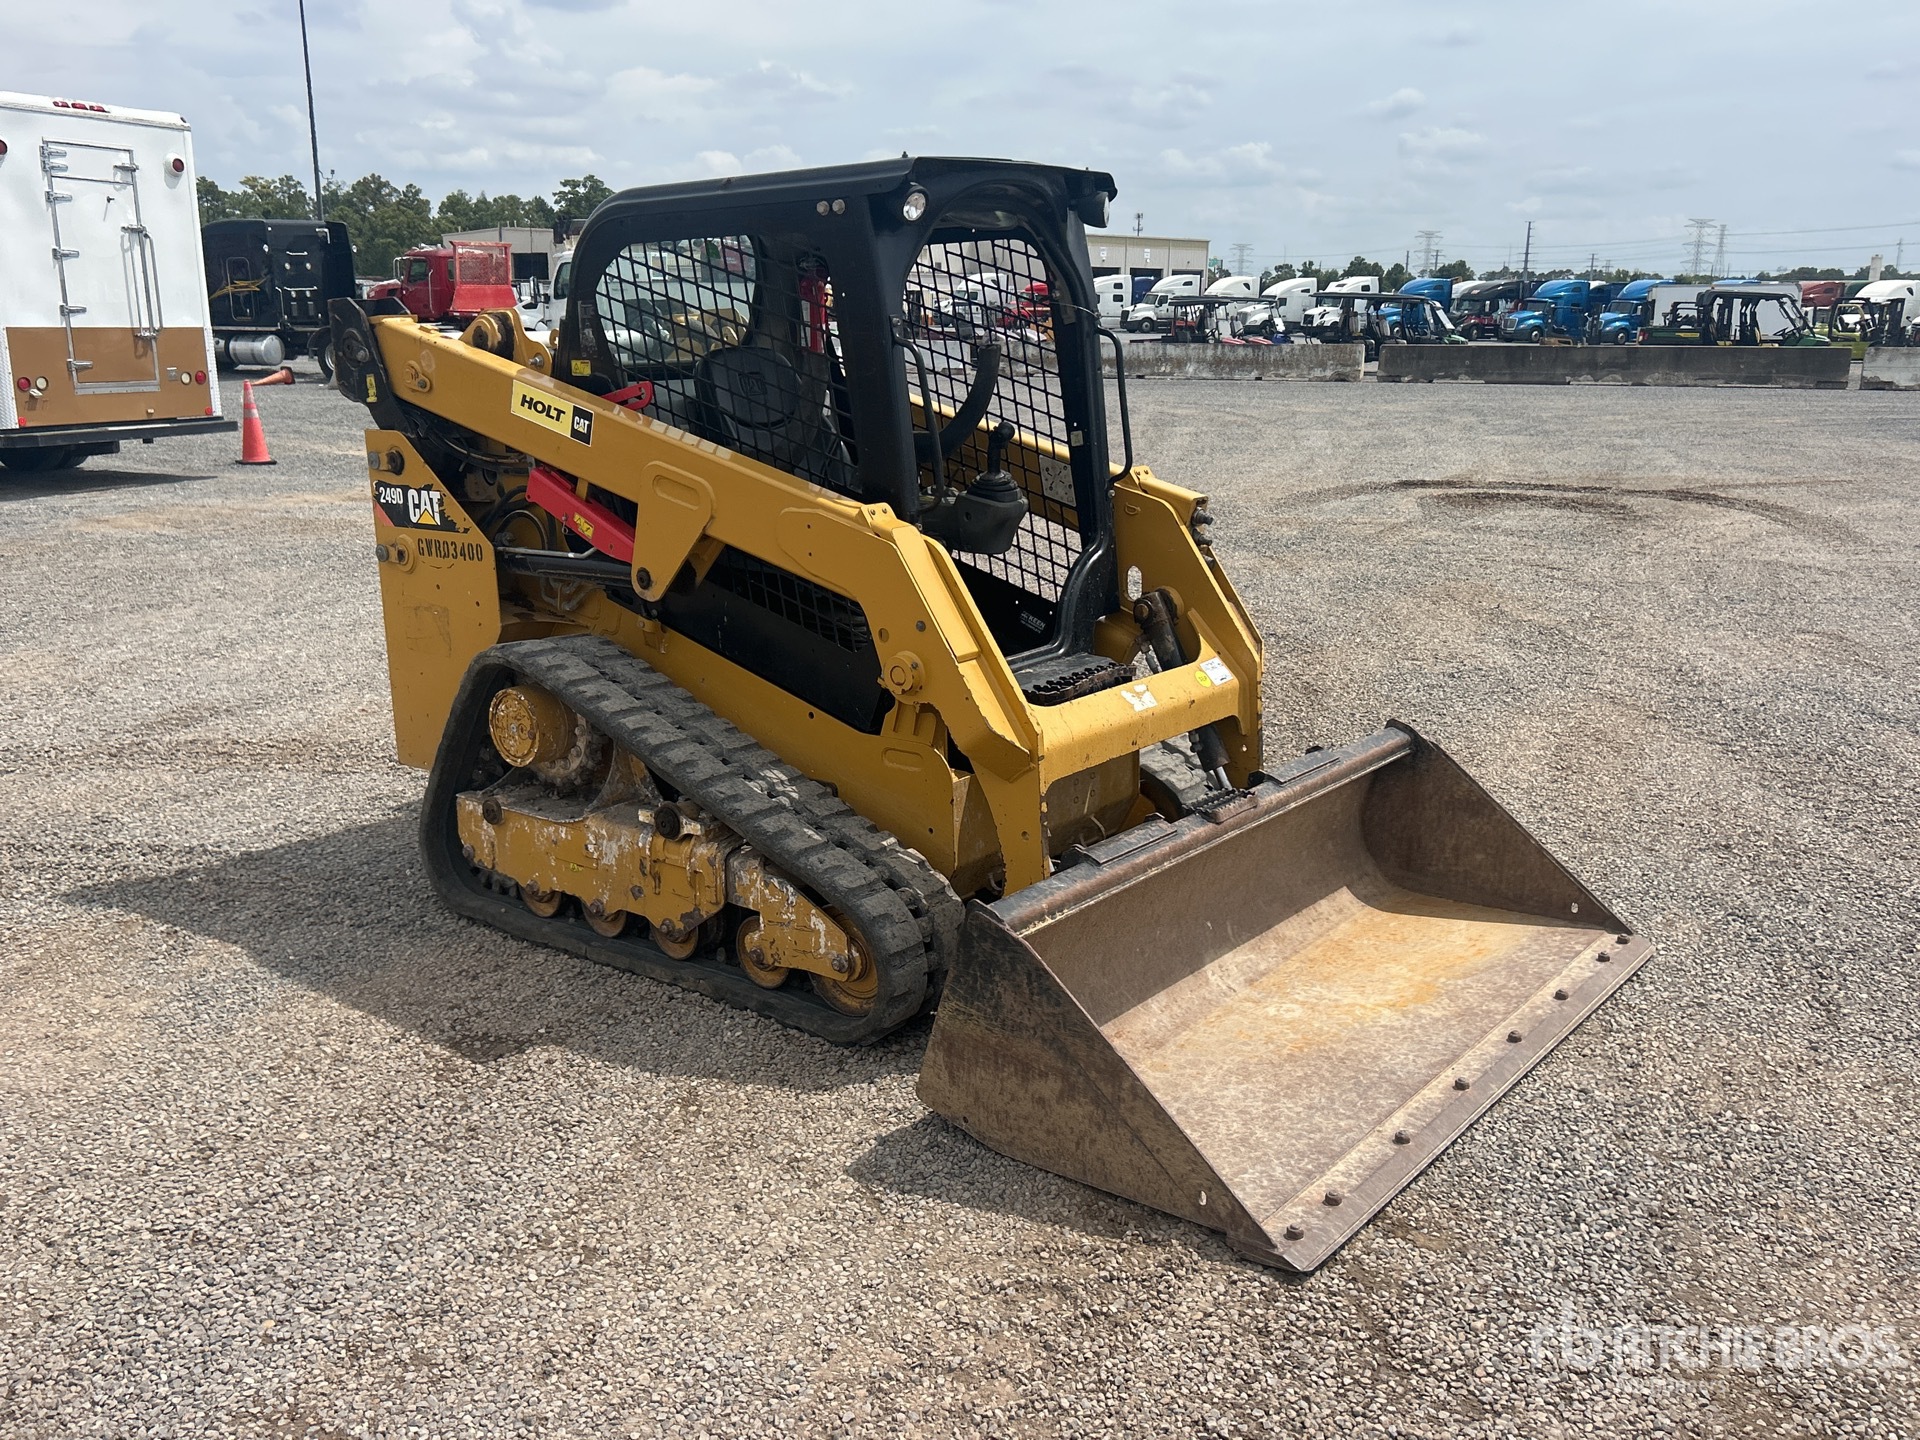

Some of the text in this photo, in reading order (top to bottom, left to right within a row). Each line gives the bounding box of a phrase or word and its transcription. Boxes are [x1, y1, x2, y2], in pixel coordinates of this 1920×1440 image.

[520, 394, 590, 434] HOLT CAT
[379, 486, 441, 526] 249D CAT
[1028, 615, 1046, 628] KEEN
